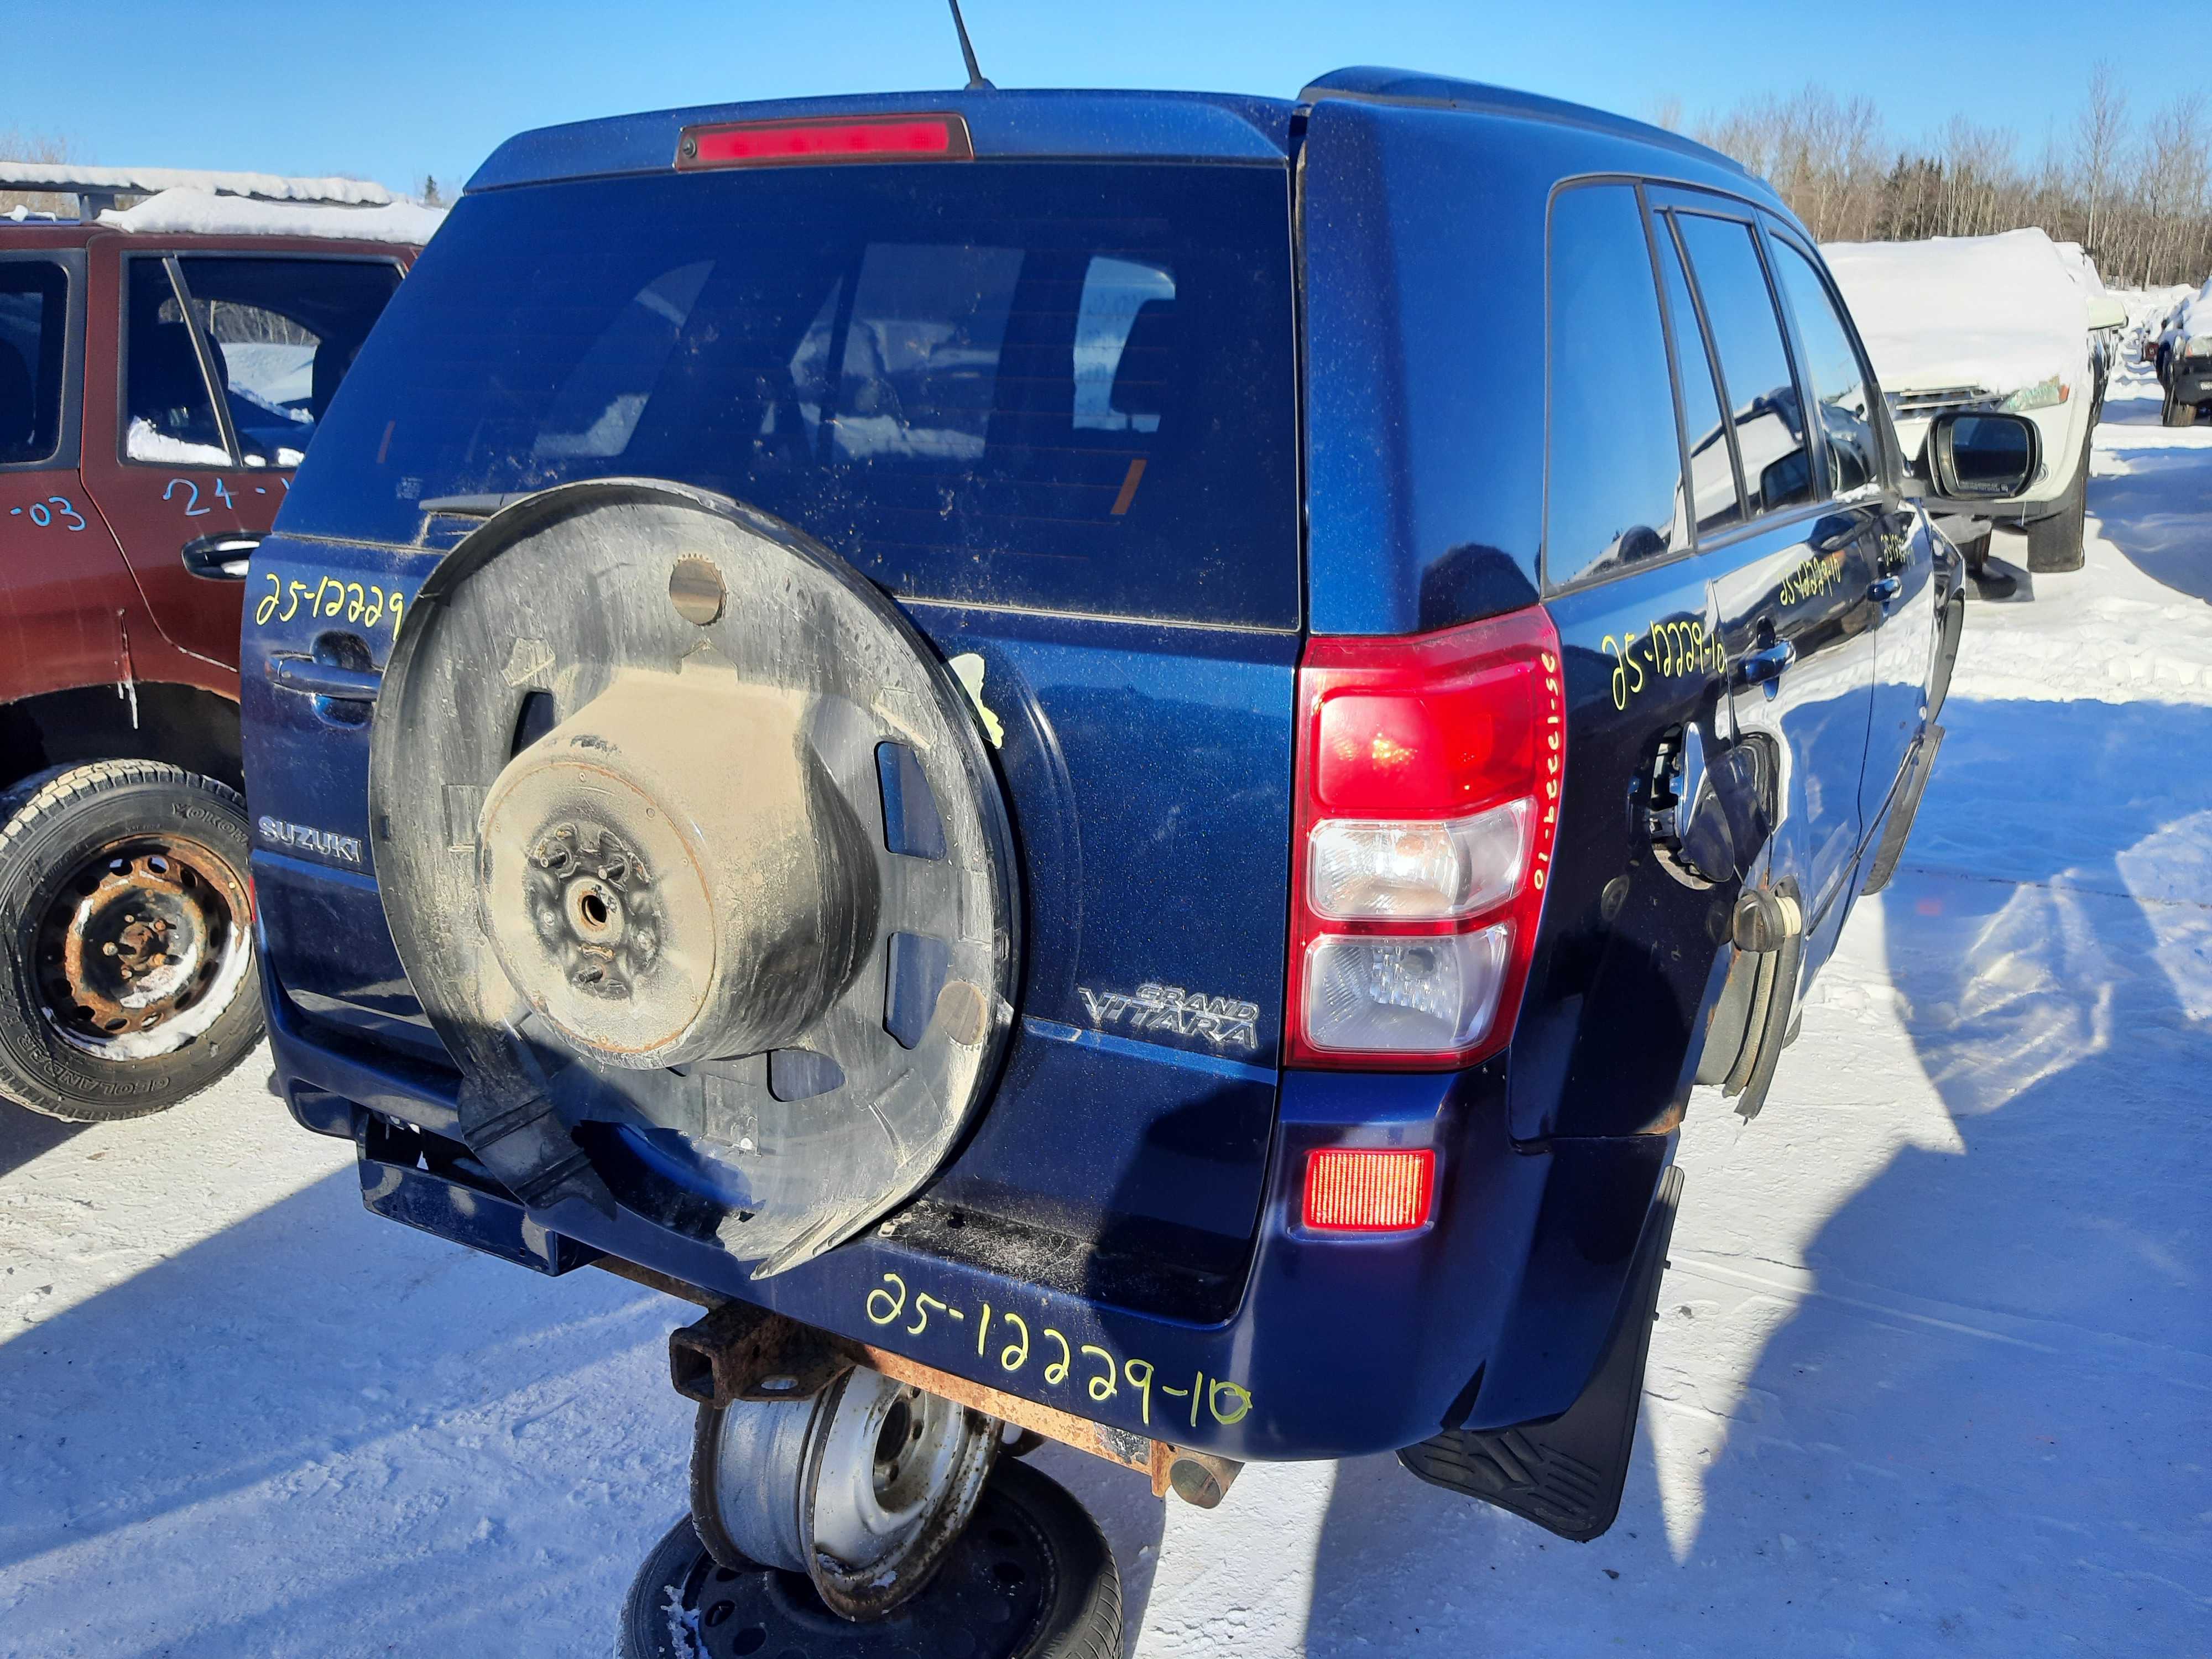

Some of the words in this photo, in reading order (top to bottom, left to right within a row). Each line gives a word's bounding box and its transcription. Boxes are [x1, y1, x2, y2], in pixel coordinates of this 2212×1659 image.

[256, 573, 403, 641] 25-12229
[1601, 620, 1725, 710] 25-12229-10
[1533, 653, 1559, 890] 25-12229-10
[258, 815, 361, 862] SUZUKI
[1078, 988, 1258, 1048] VITARA
[1136, 984, 1259, 1021] GRAND
[866, 1273, 1253, 1427] 25-12229-10
